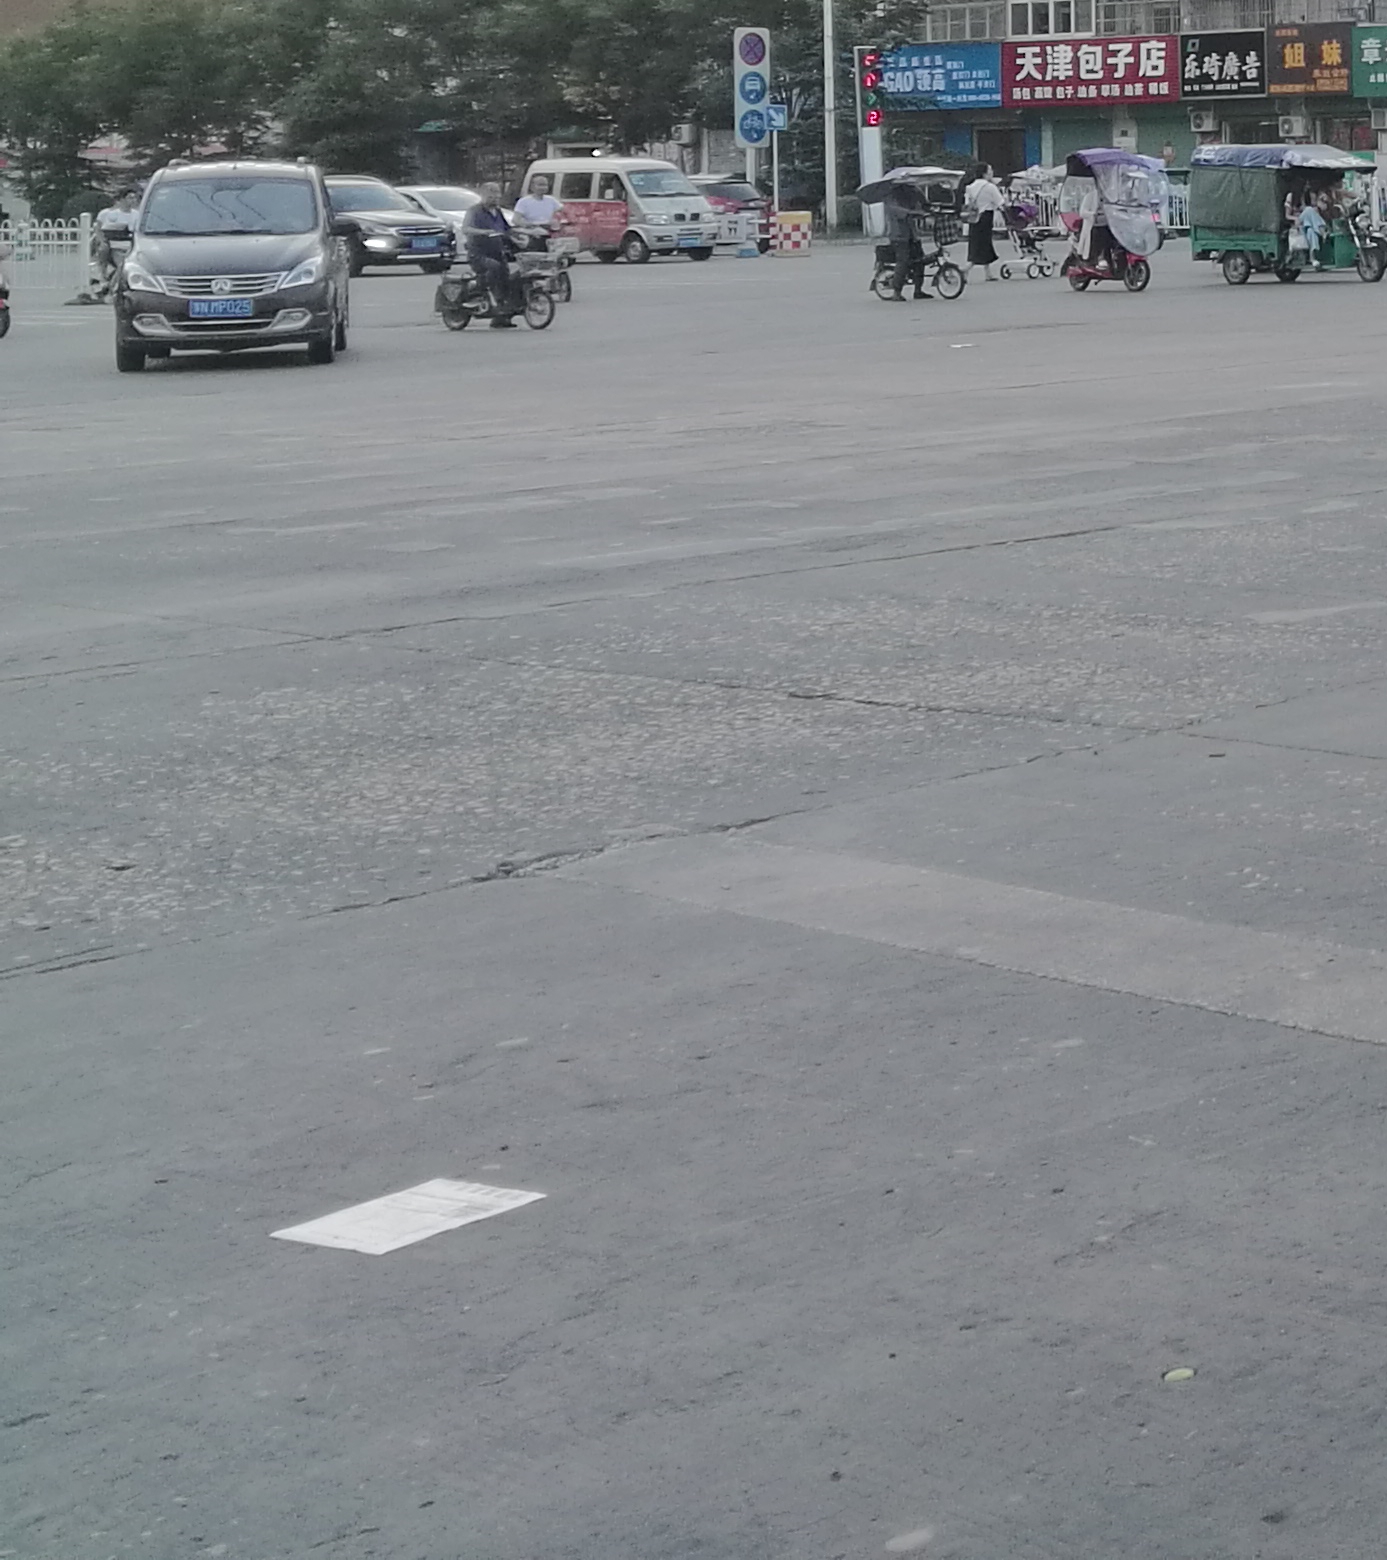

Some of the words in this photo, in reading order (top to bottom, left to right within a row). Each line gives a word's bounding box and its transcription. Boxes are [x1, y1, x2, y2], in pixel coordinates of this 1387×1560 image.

[1015, 41, 1167, 81] 天津包子店
